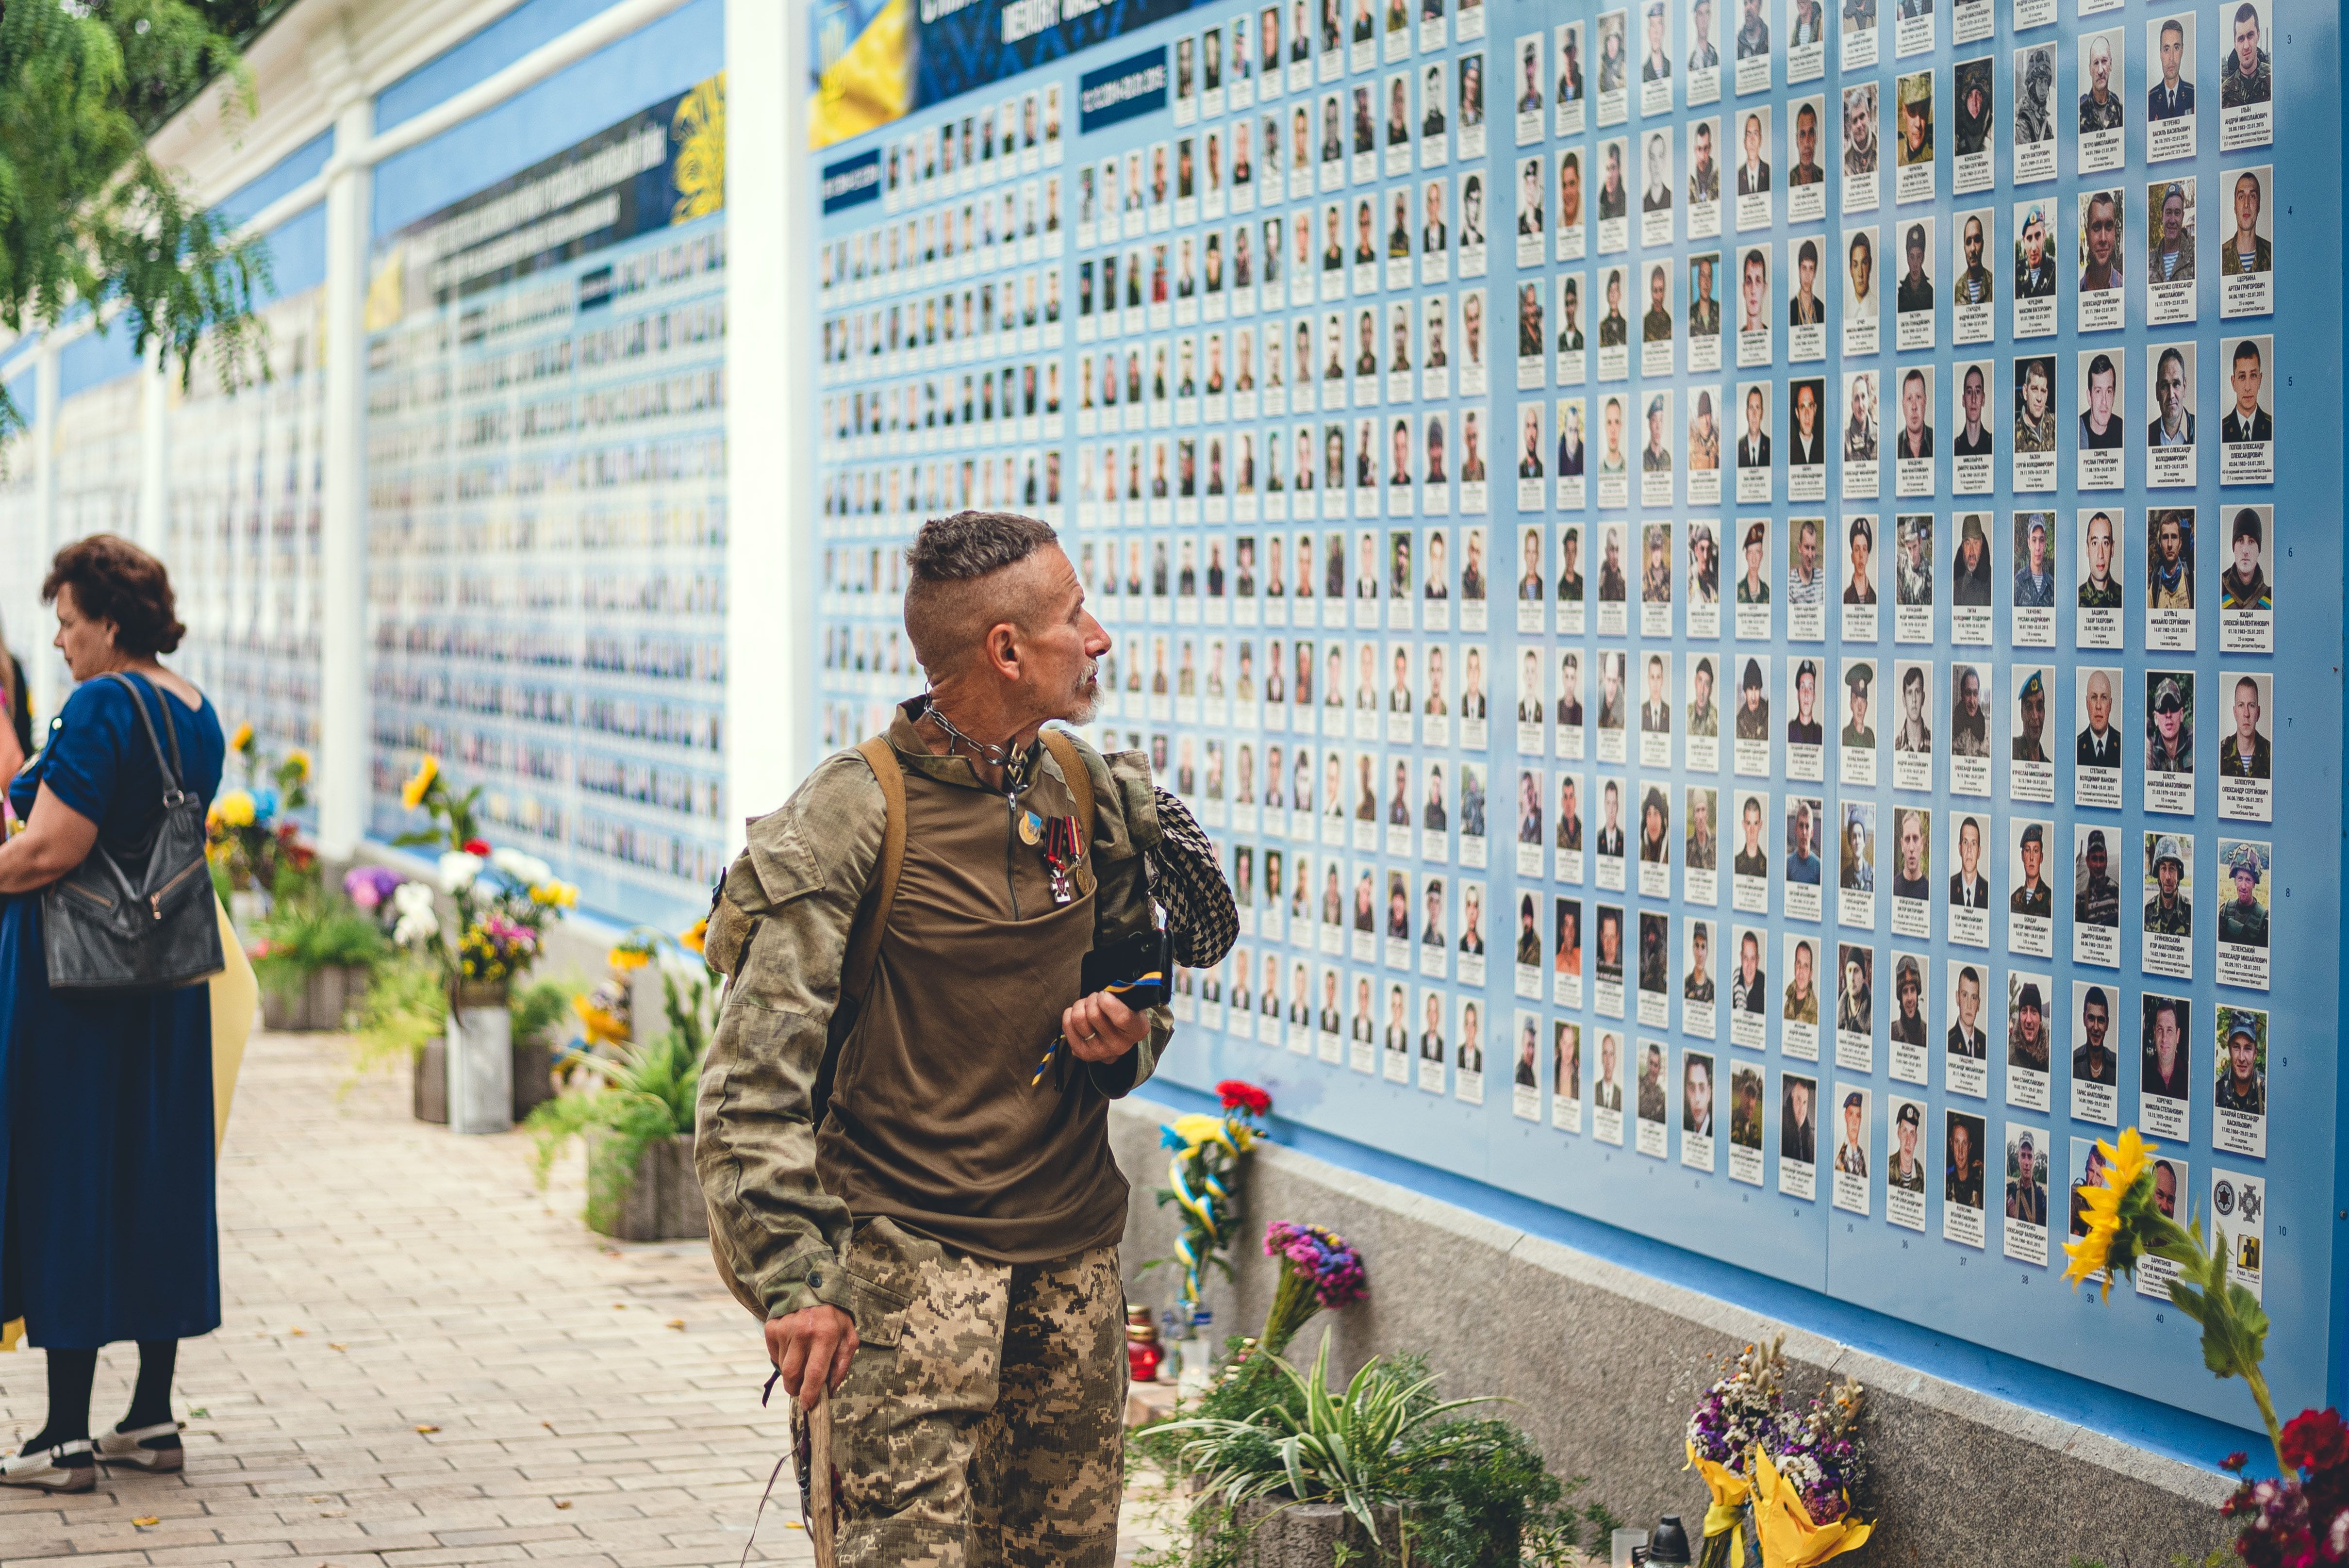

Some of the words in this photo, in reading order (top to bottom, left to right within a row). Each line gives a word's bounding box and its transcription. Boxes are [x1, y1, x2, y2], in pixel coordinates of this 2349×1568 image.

[2287, 35, 2291, 44] 3
[2225, 116, 2238, 125] АНДРІЙ
[2239, 112, 2267, 122] МИКОЛАЙОВИЧ
[2288, 206, 2292, 215] 4
[2237, 274, 2256, 283] ЩЕРБИНА
[2241, 282, 2265, 290] ГРИГОРОВИЧ
[2288, 377, 2292, 386] 5
[2288, 547, 2292, 557] 6
[2288, 718, 2292, 727] 7
[2222, 786, 2244, 794] ОЛЕКСАНДР
[2286, 888, 2290, 897] 8
[2231, 945, 2255, 954] ЗЕЛЕНСЬКИЙ
[2218, 952, 2240, 961] ОЛЕКСАНДР
[2241, 955, 2267, 964] МИХАЙЛОВИЧ
[2283, 1057, 2287, 1067] 9
[2220, 1108, 2236, 1118] ШАХРАЙ
[2236, 1112, 2259, 1123] ОЛЕКСАНДР
[2227, 1119, 2251, 1129] ВАСИЛЬОВИЧ
[2279, 1225, 2286, 1236] 10
[2022, 1274, 2029, 1285] 38
[2087, 1293, 2094, 1304] 39
[2156, 1313, 2164, 1323] 40
